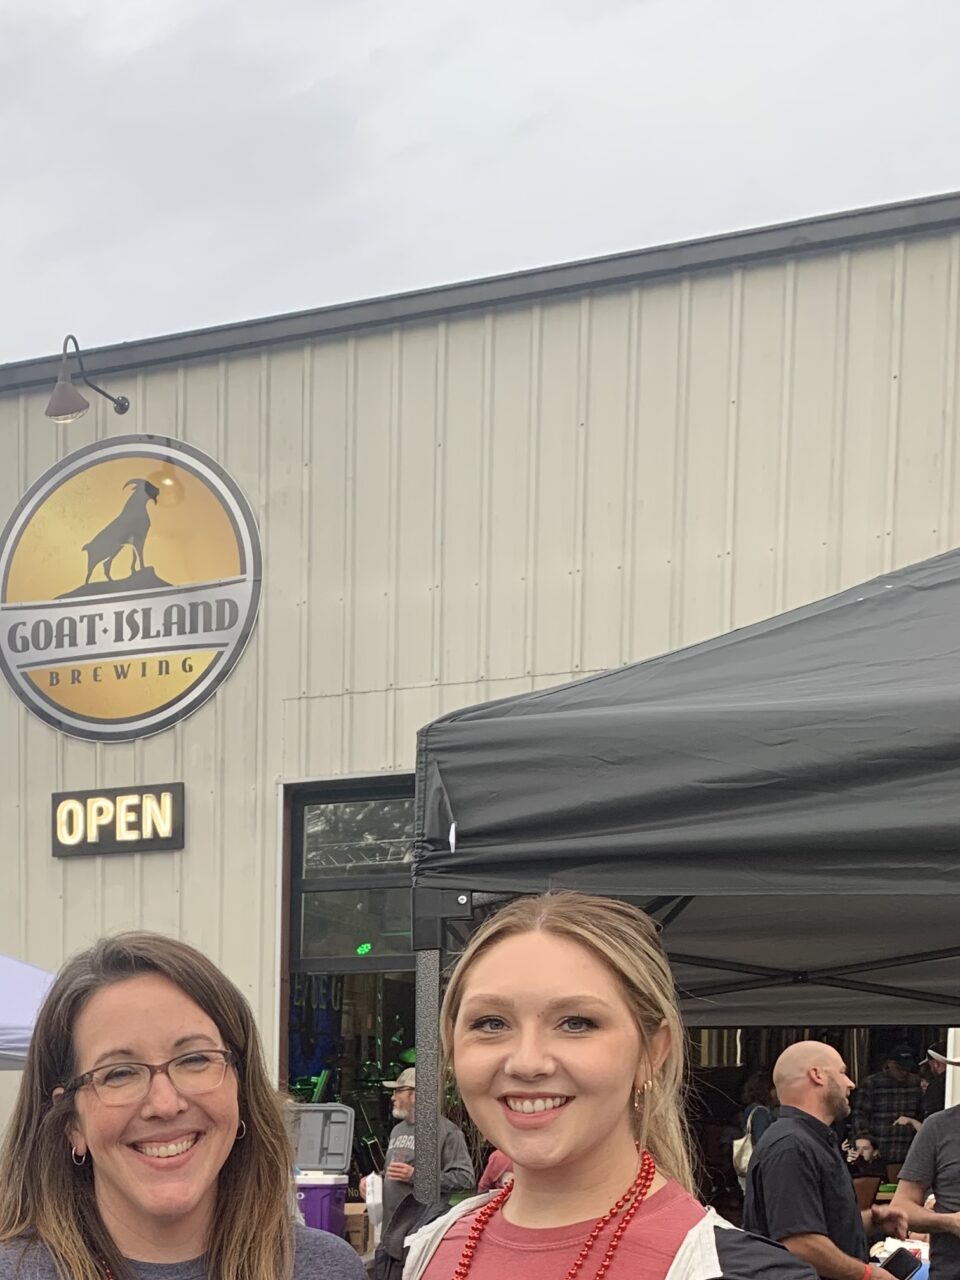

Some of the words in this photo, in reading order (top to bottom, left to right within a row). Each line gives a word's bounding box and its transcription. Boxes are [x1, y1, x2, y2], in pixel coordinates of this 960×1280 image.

[7, 613, 103, 653] GOAT
[113, 598, 240, 642] ISLAND
[49, 656, 195, 687] BREWING
[56, 792, 174, 846] OPEN
